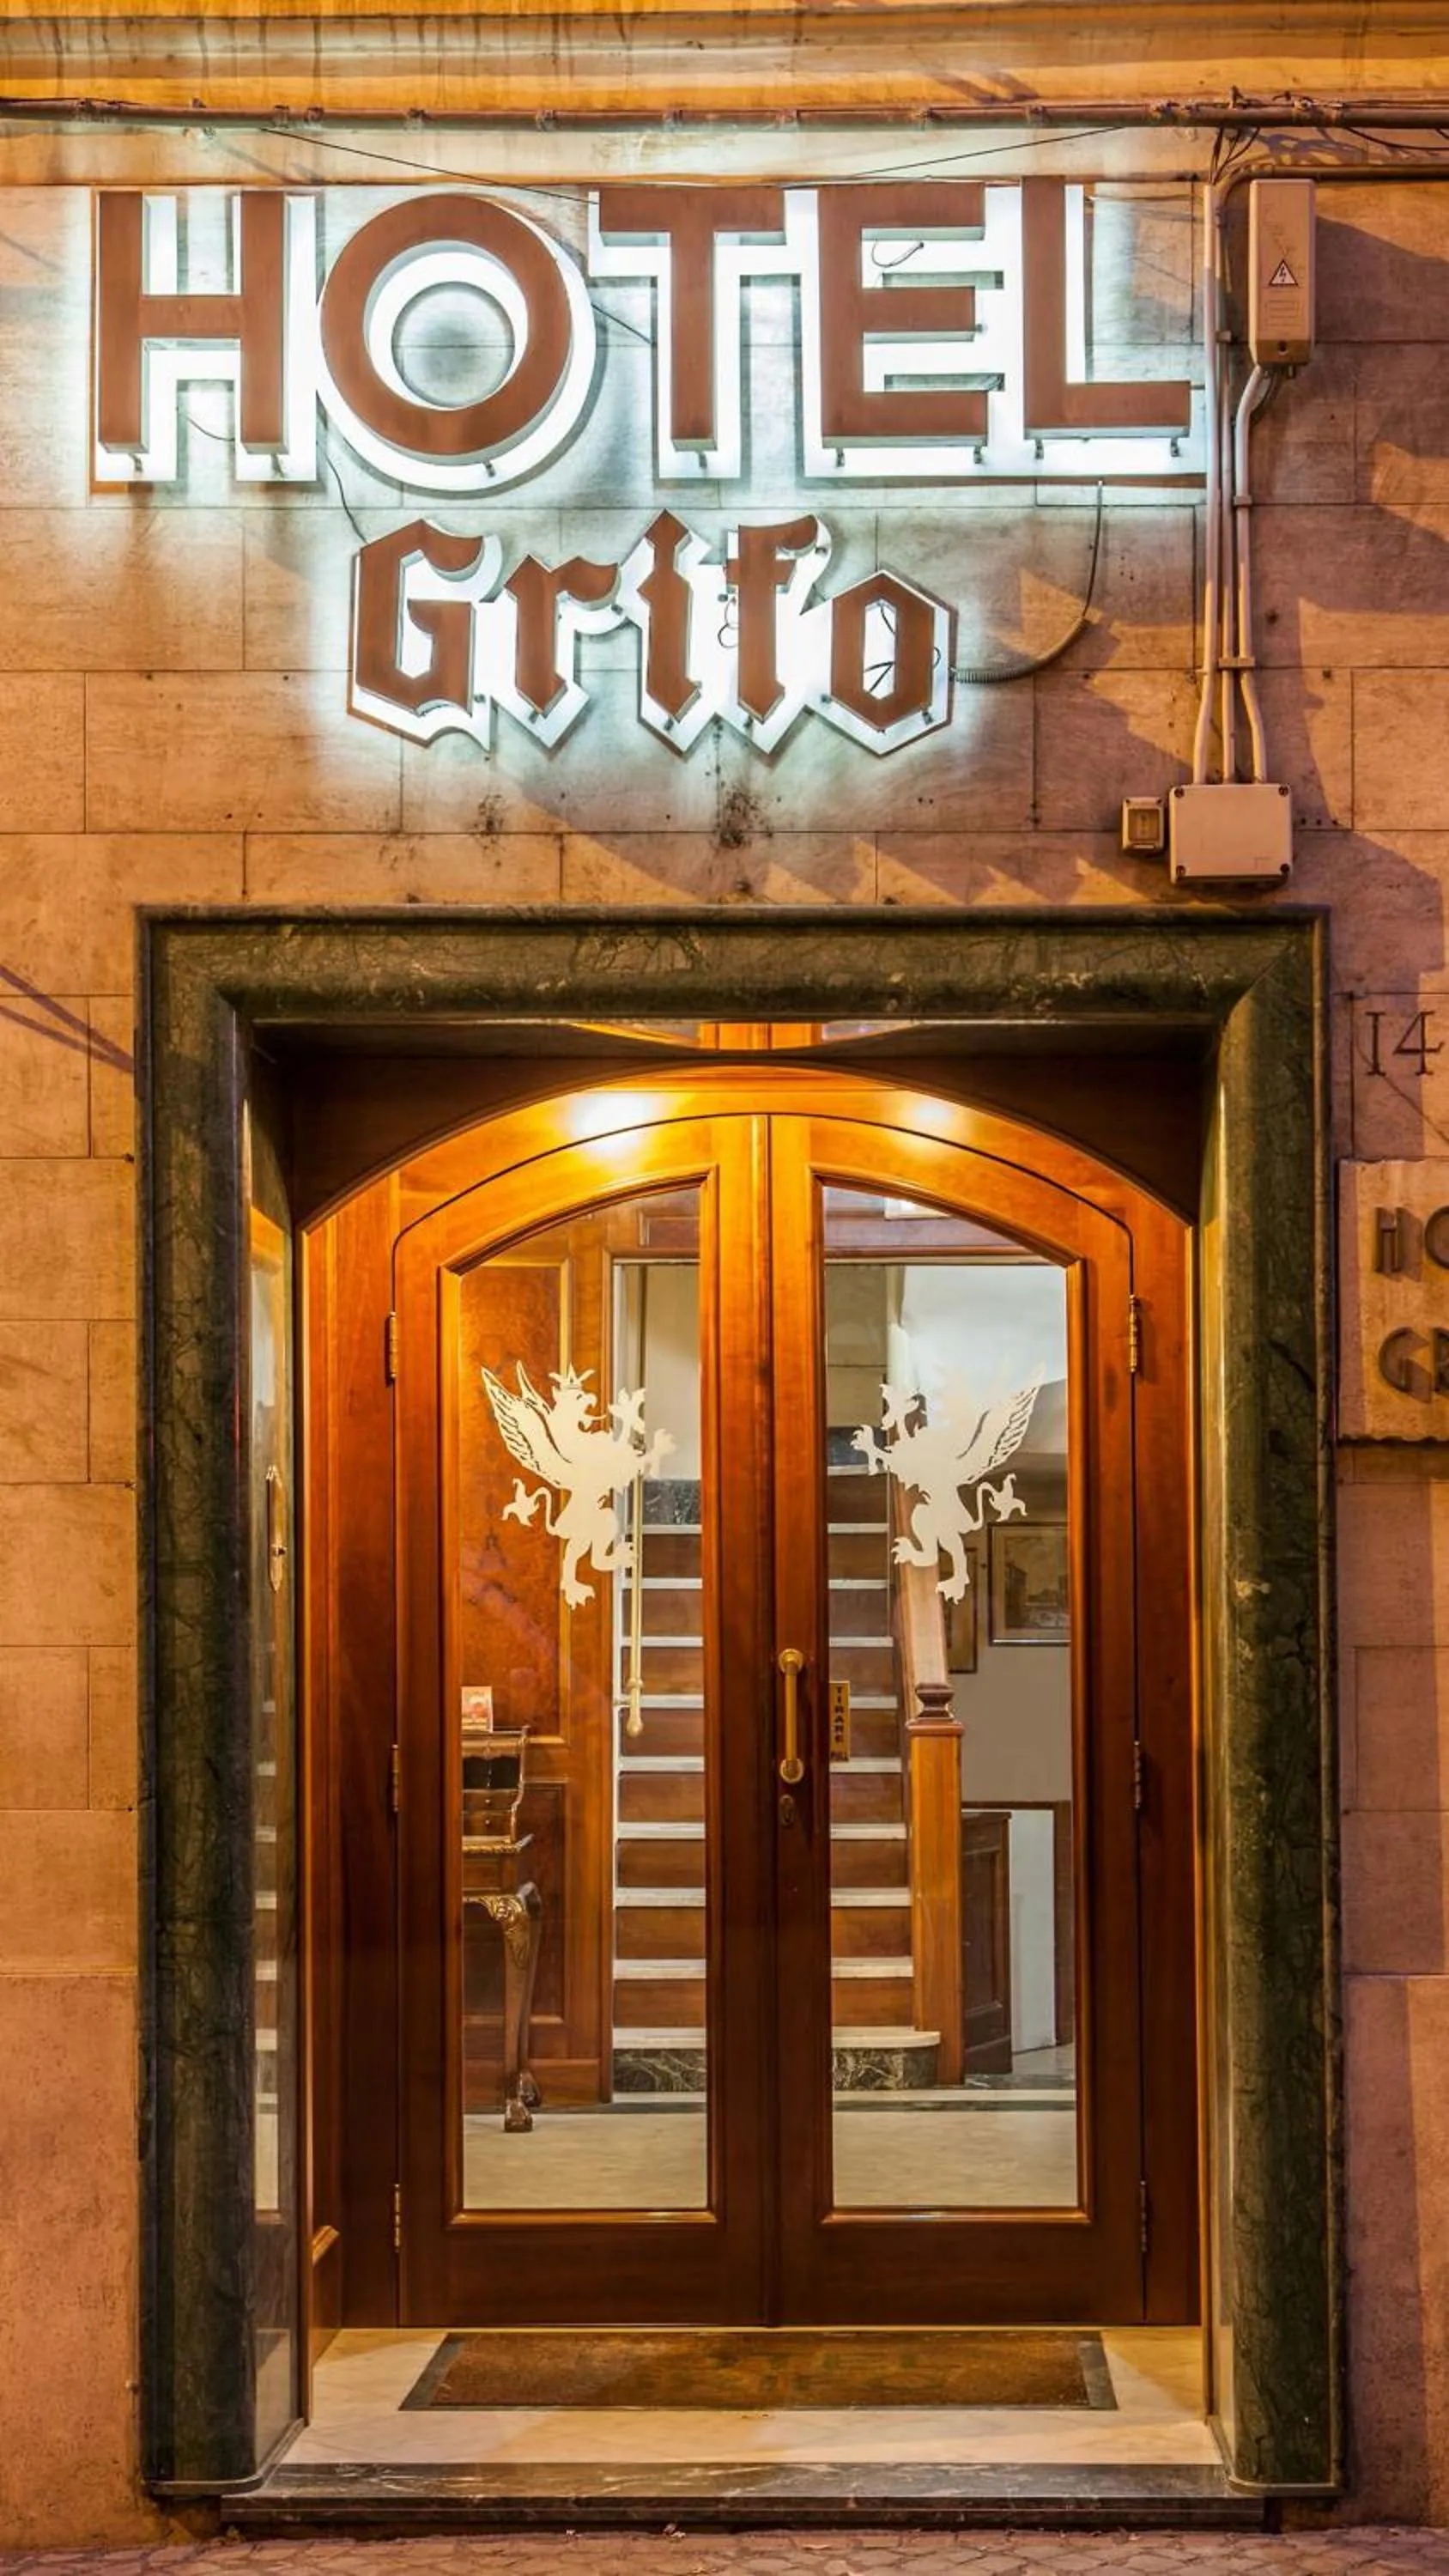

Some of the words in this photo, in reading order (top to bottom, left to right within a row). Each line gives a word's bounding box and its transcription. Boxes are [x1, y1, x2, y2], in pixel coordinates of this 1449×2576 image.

[91, 176, 1206, 486] HOTEL
[347, 508, 955, 756] Grifo
[1364, 1011, 1445, 1077] 14
